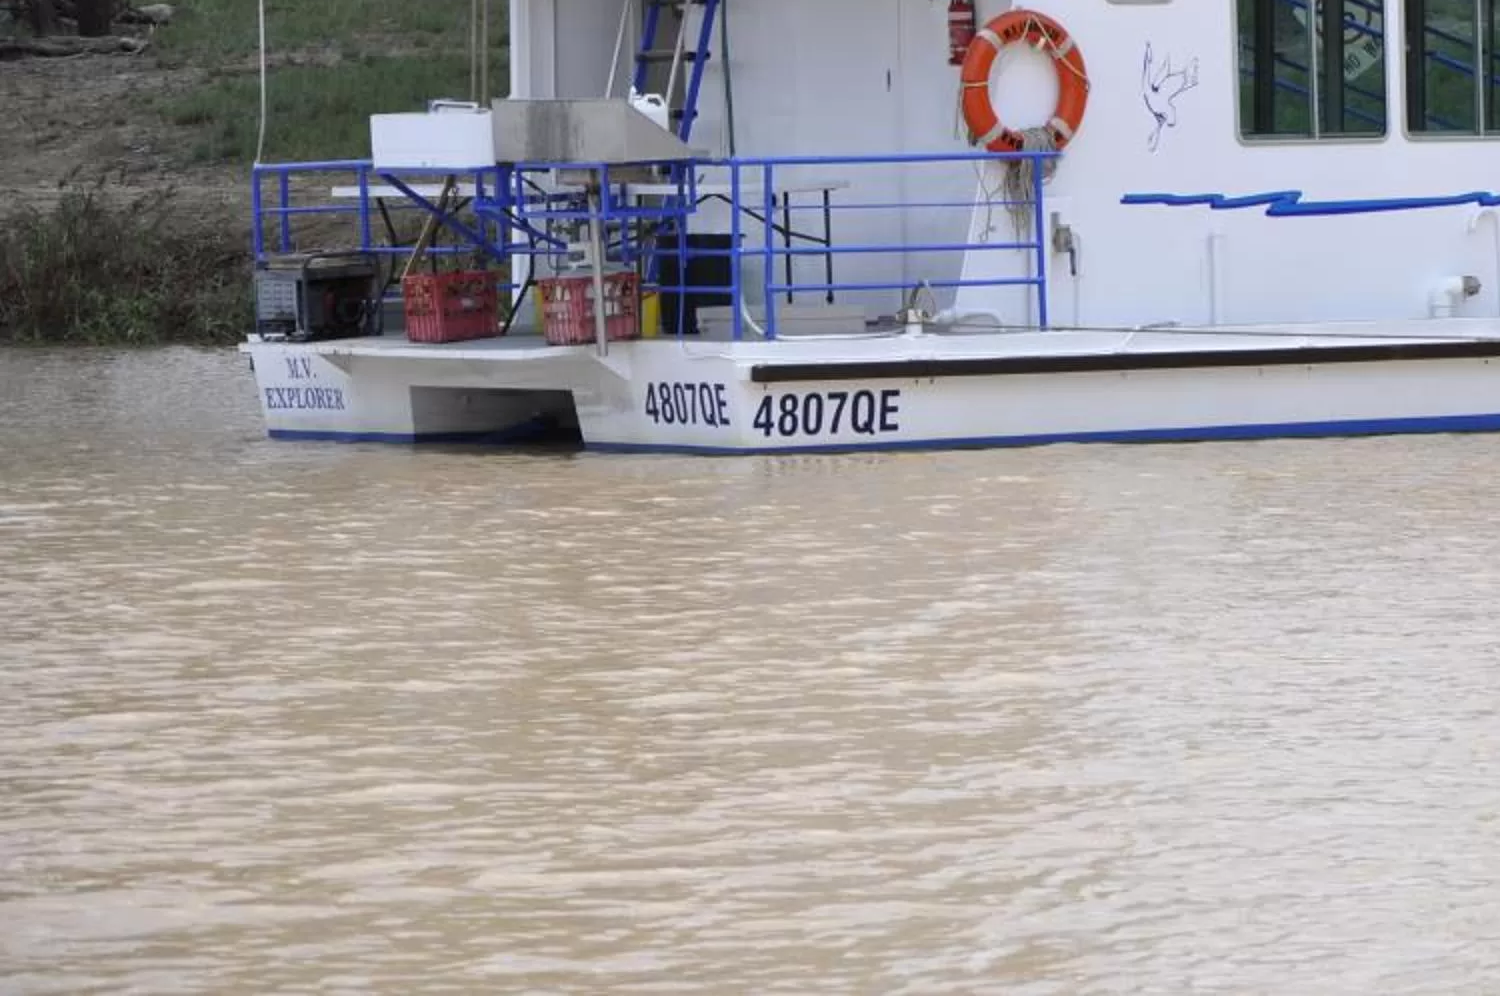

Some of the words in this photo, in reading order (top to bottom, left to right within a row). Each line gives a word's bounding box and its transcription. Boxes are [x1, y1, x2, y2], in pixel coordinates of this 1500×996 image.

[264, 387, 345, 410] EXPLORER
[645, 382, 731, 428] 4807QE
[753, 389, 901, 437] 4807QE
